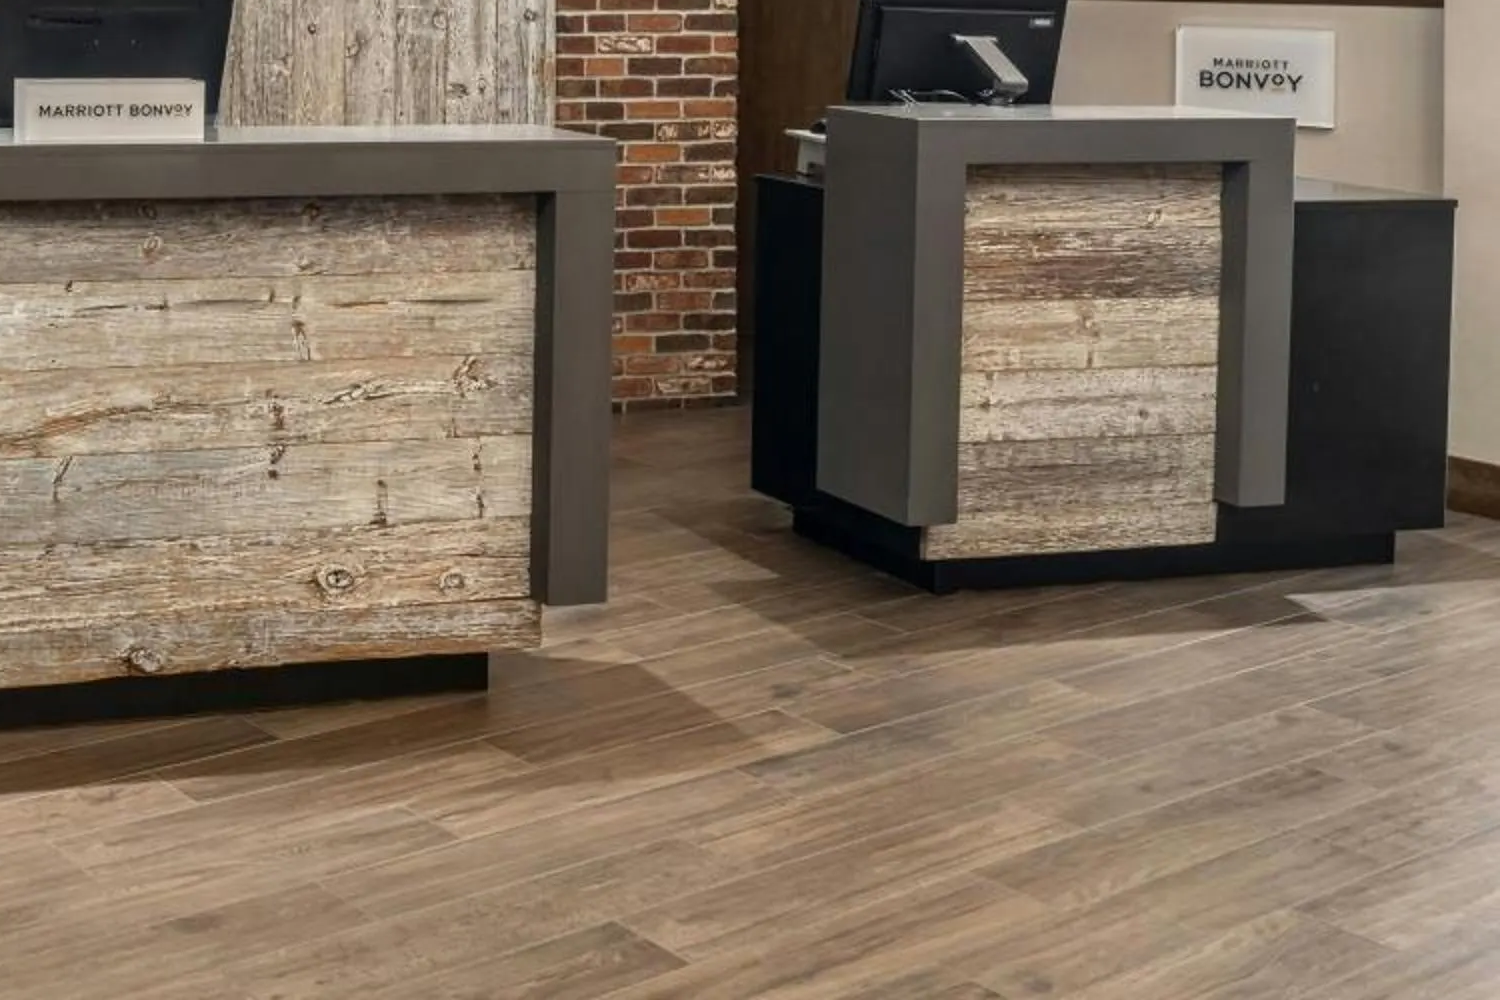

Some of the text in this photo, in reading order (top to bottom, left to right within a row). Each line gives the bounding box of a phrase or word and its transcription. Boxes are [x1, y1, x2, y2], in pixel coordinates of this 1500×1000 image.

[1213, 57, 1289, 71] MARRIOTT
[1199, 70, 1303, 93] BONVOY
[38, 104, 193, 118] MARRIOTT BONVOY
